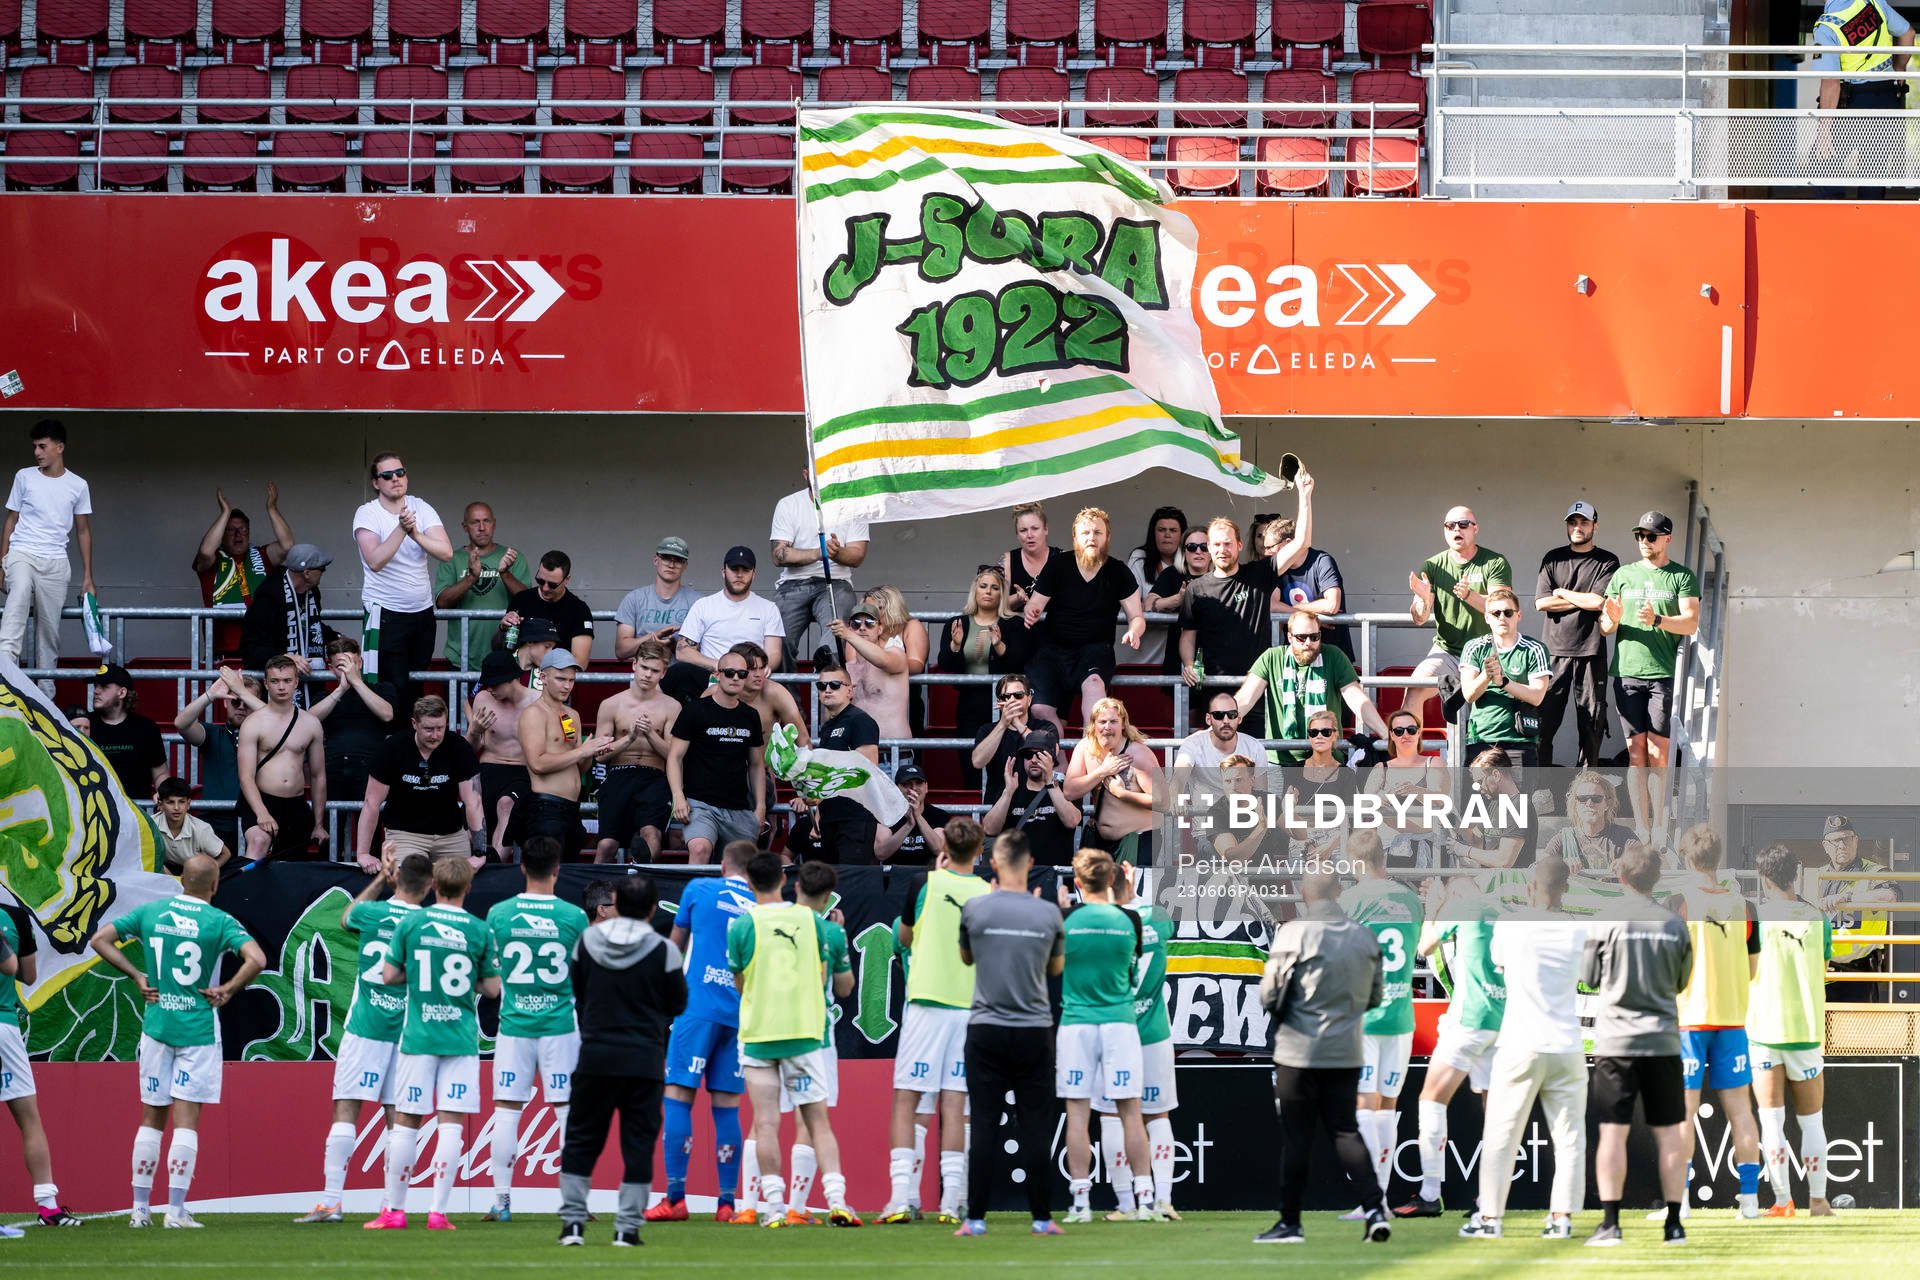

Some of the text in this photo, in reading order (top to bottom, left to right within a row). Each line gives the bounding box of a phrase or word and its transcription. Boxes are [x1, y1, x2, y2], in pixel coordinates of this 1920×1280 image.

[204, 238, 450, 323] akea
[1200, 263, 1321, 328] ea
[896, 279, 1130, 390] 1922
[264, 347, 505, 365] PART OF ELEDA
[1208, 352, 1376, 369] OF ELEDA
[1575, 502, 1583, 512] P
[149, 937, 202, 986] 13
[503, 941, 569, 985] 23
[414, 949, 473, 997] 18
[688, 1056, 706, 1074] JP
[910, 1061, 930, 1078] JP
[1732, 1054, 1747, 1073] JP
[147, 1076, 160, 1093] JP
[174, 1069, 190, 1087] JP
[359, 1071, 380, 1088] JP
[499, 1071, 516, 1087] JP
[550, 1073, 568, 1089] JP
[1066, 1070, 1084, 1086] JP
[1113, 1070, 1131, 1086] JP
[407, 1086, 423, 1102] JP
[447, 1083, 467, 1099] JP
[1141, 1086, 1160, 1102] JP
